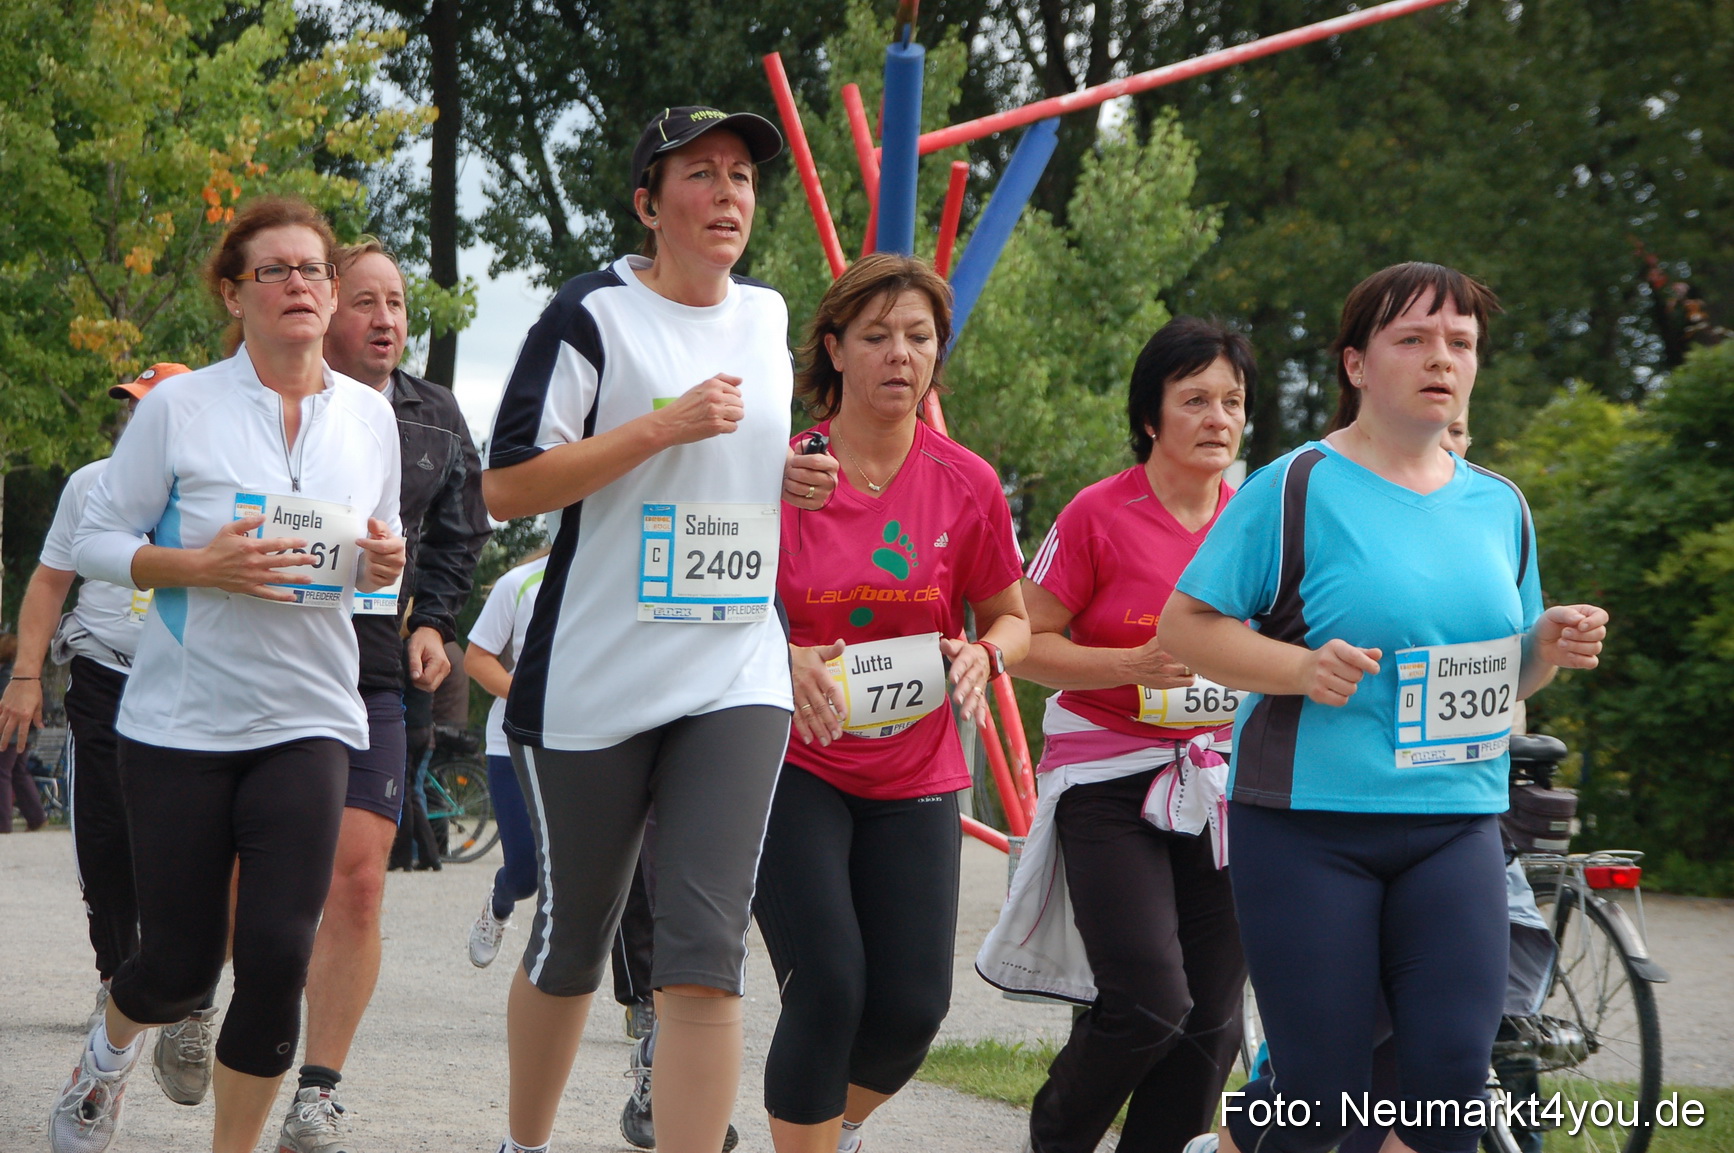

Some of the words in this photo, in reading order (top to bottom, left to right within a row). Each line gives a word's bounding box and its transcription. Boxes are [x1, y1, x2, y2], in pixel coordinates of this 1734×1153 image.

[272, 505, 323, 531] Angela
[685, 514, 739, 536] Sabina
[652, 547, 661, 563] C
[685, 549, 762, 580] 2409
[806, 585, 940, 604] Laufbox.de
[851, 655, 893, 675] Jutta
[1438, 655, 1507, 678] Christine
[867, 679, 924, 713] 772
[1184, 687, 1239, 714] 565
[1438, 683, 1510, 721] 3302
